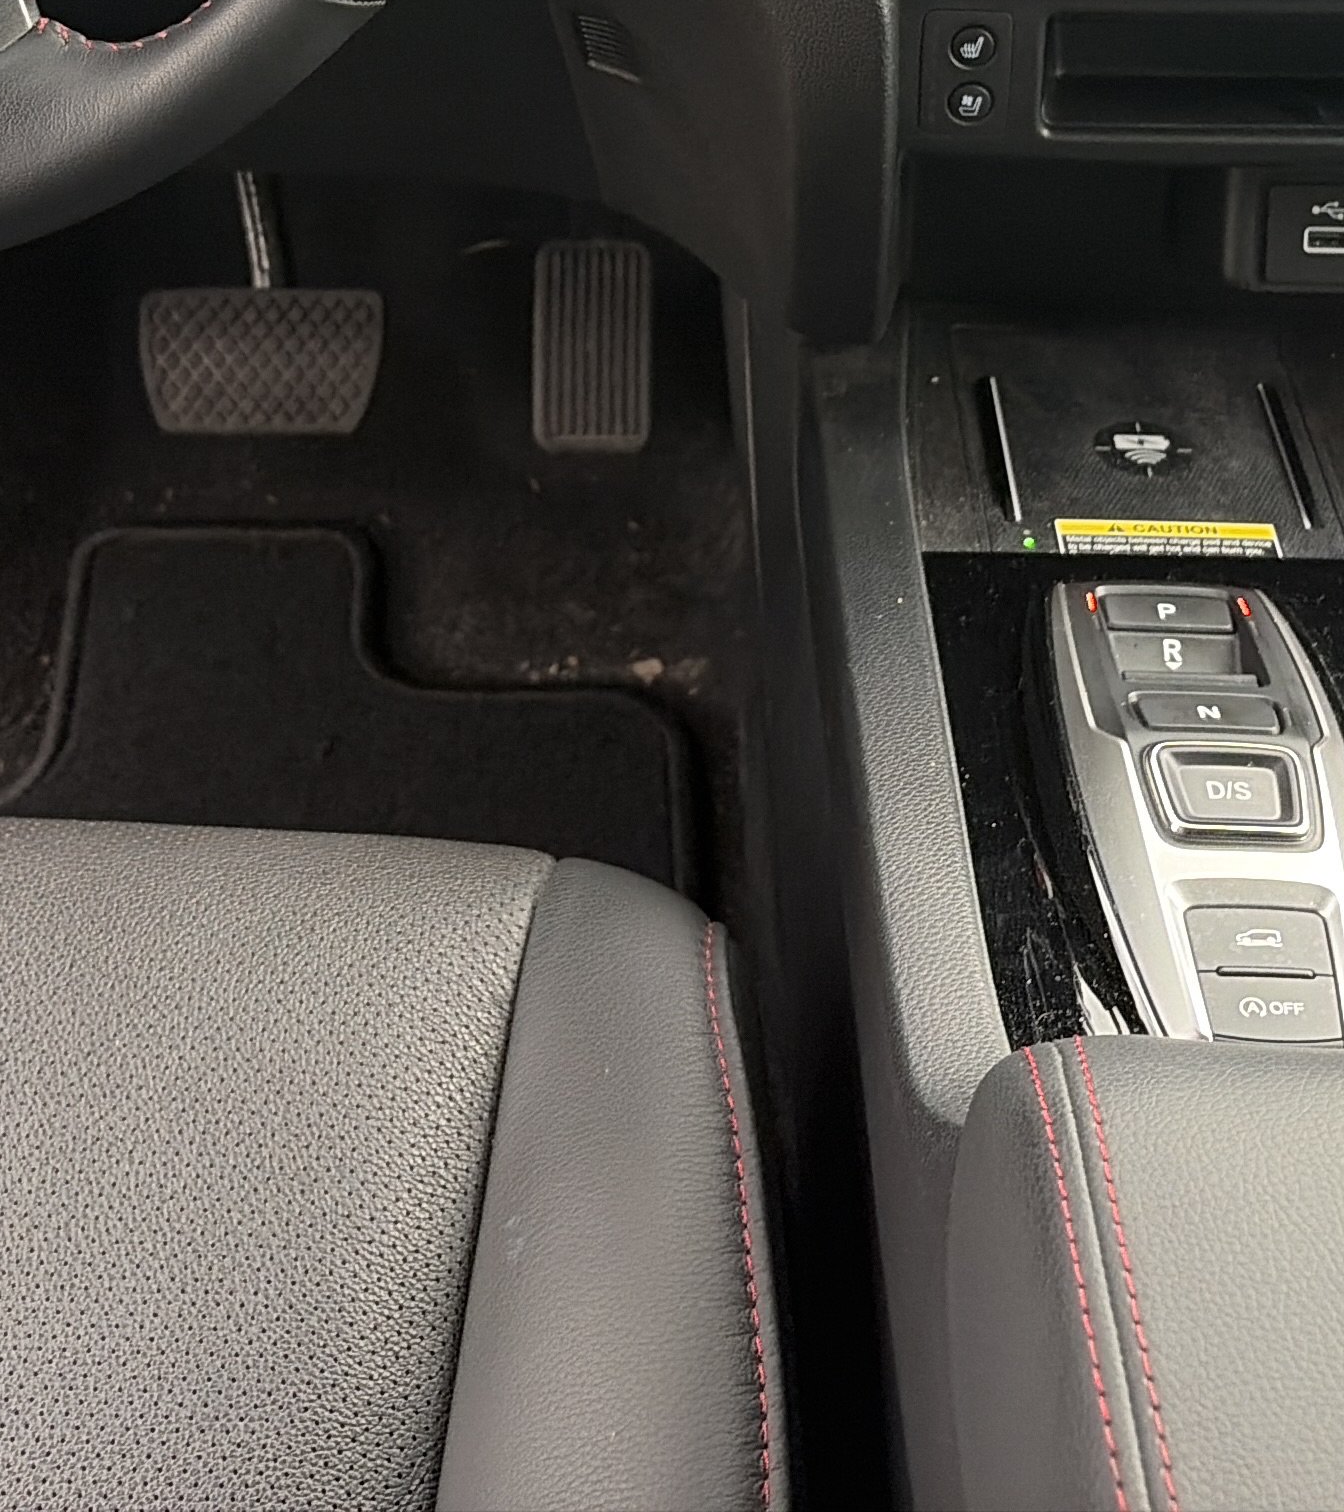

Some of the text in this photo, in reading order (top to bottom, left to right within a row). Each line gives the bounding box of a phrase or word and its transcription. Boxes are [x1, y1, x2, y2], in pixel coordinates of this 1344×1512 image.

[1132, 523, 1218, 535] CAUTION
[1156, 602, 1177, 621] P
[1162, 638, 1183, 663] R
[1196, 704, 1222, 720] N
[1205, 779, 1252, 801] D/S
[1268, 1001, 1305, 1016] OFF
